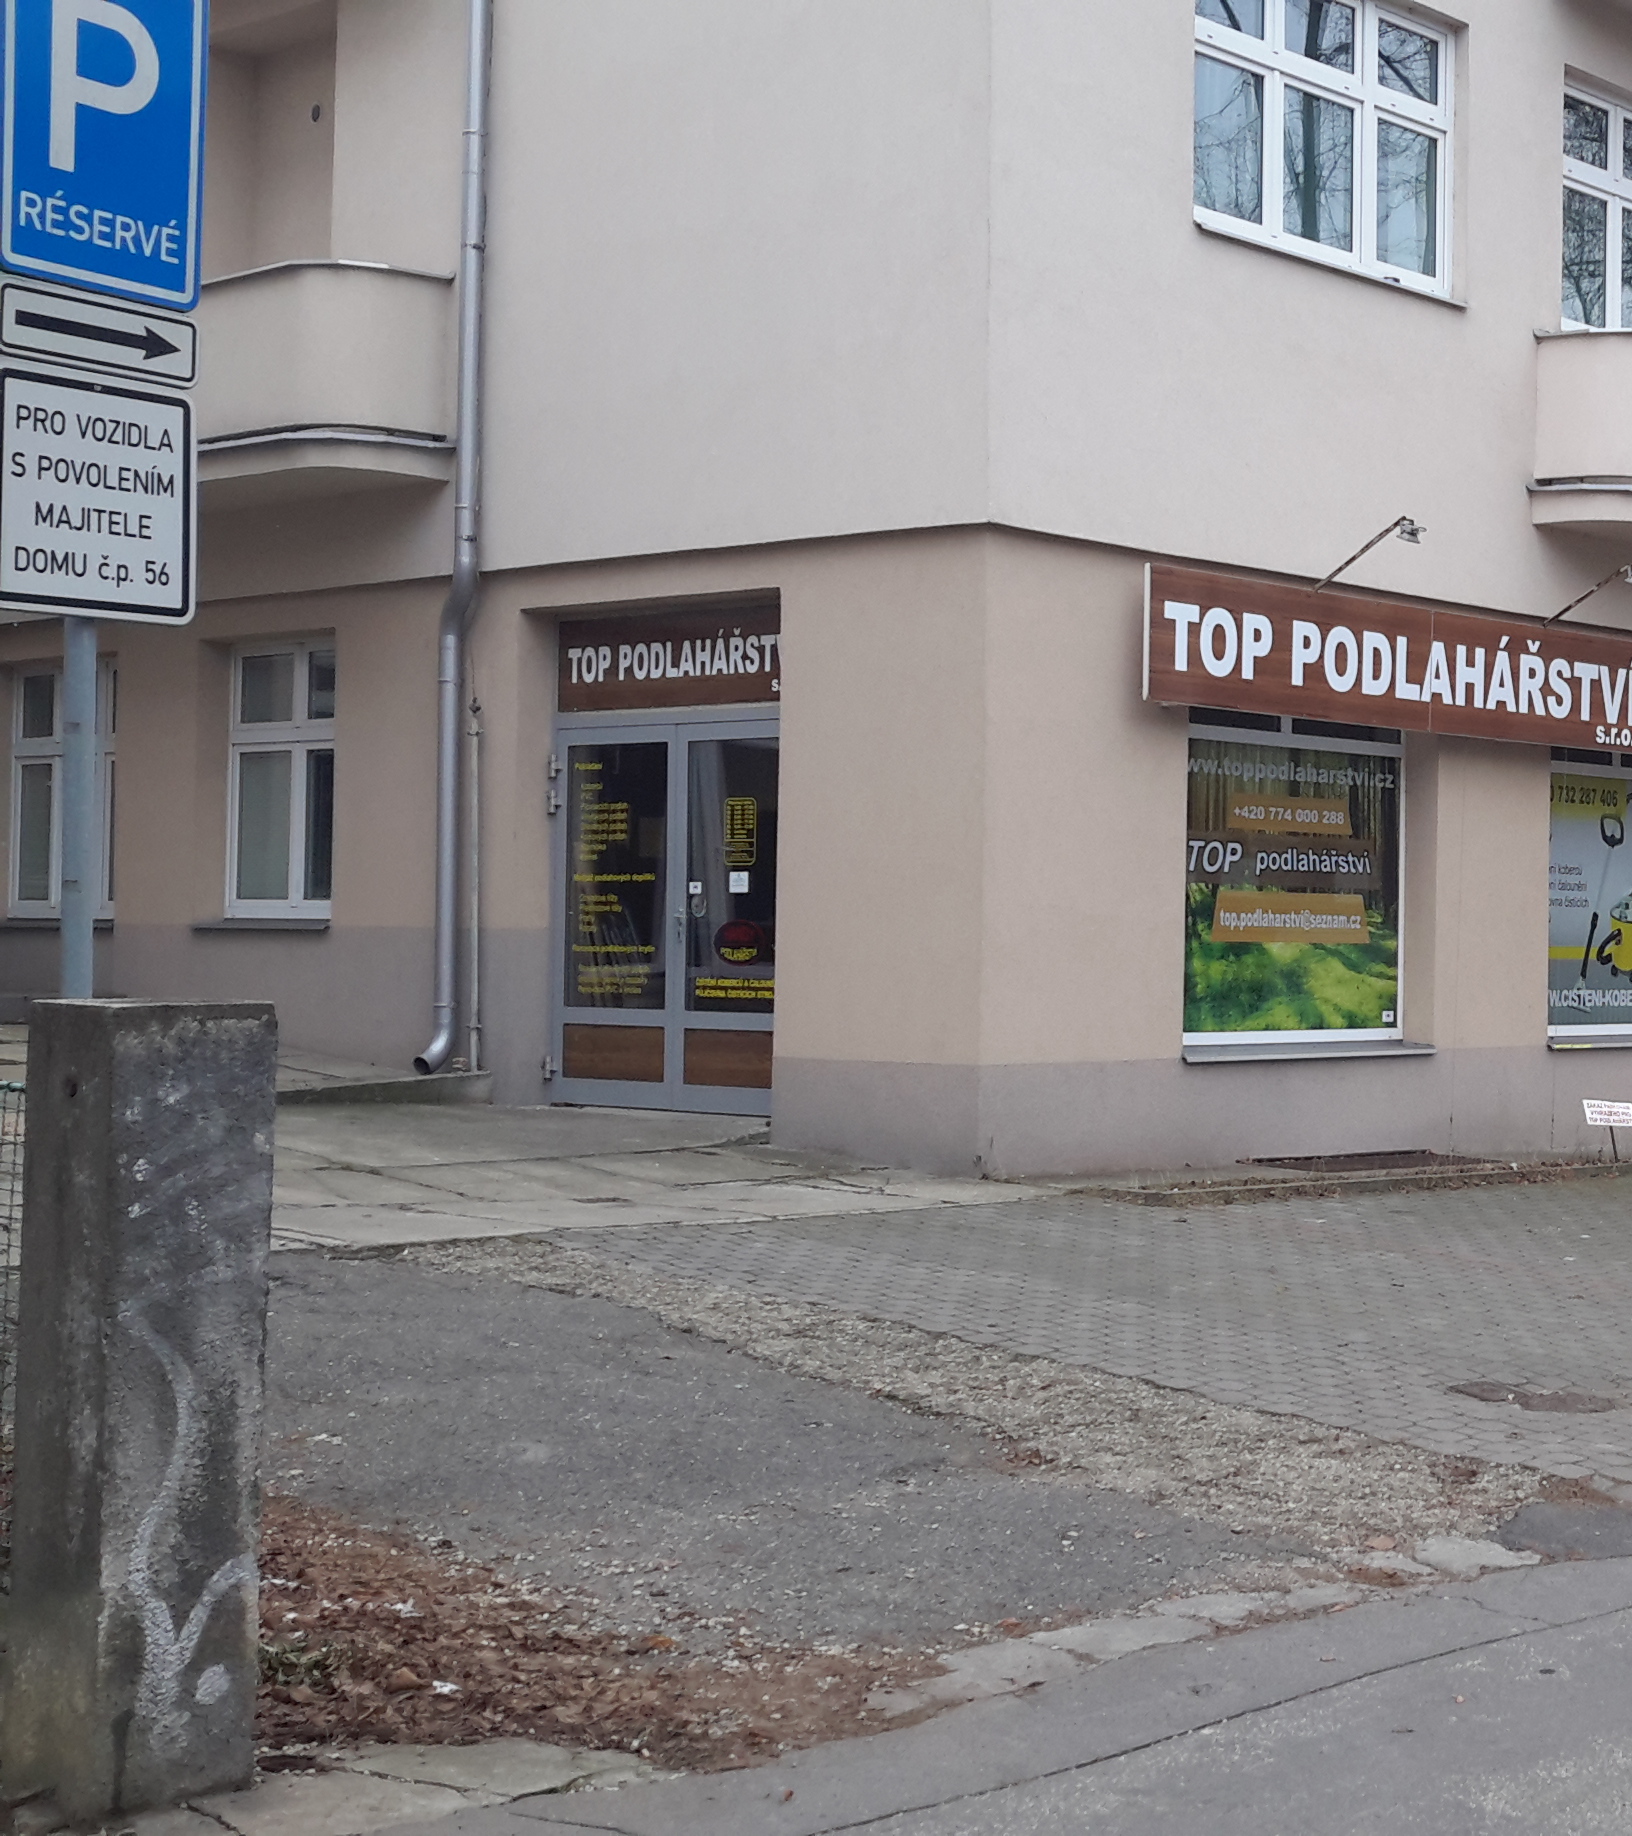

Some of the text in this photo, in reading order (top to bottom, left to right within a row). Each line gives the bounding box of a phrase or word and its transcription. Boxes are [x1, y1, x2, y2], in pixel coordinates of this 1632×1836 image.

[49, 0, 160, 173] P
[18, 189, 182, 265] RÉSERVÉ
[16, 403, 174, 454] PRO VOZIDLA
[10, 451, 175, 498] S POVOLENÍM
[34, 500, 153, 540] MAJITELE
[14, 545, 170, 588] DOMU č.p. 56
[567, 627, 780, 684] TOP PODLAHÁŘST
[1163, 600, 1274, 681] TOP
[1233, 805, 1345, 825] +420 774 000 288
[1557, 784, 1577, 804] 732
[1599, 788, 1619, 808] 406
[1187, 839, 1372, 876] TOP podlahářství
[1219, 908, 1362, 931] top.podlaharstvi@seznam.cz
